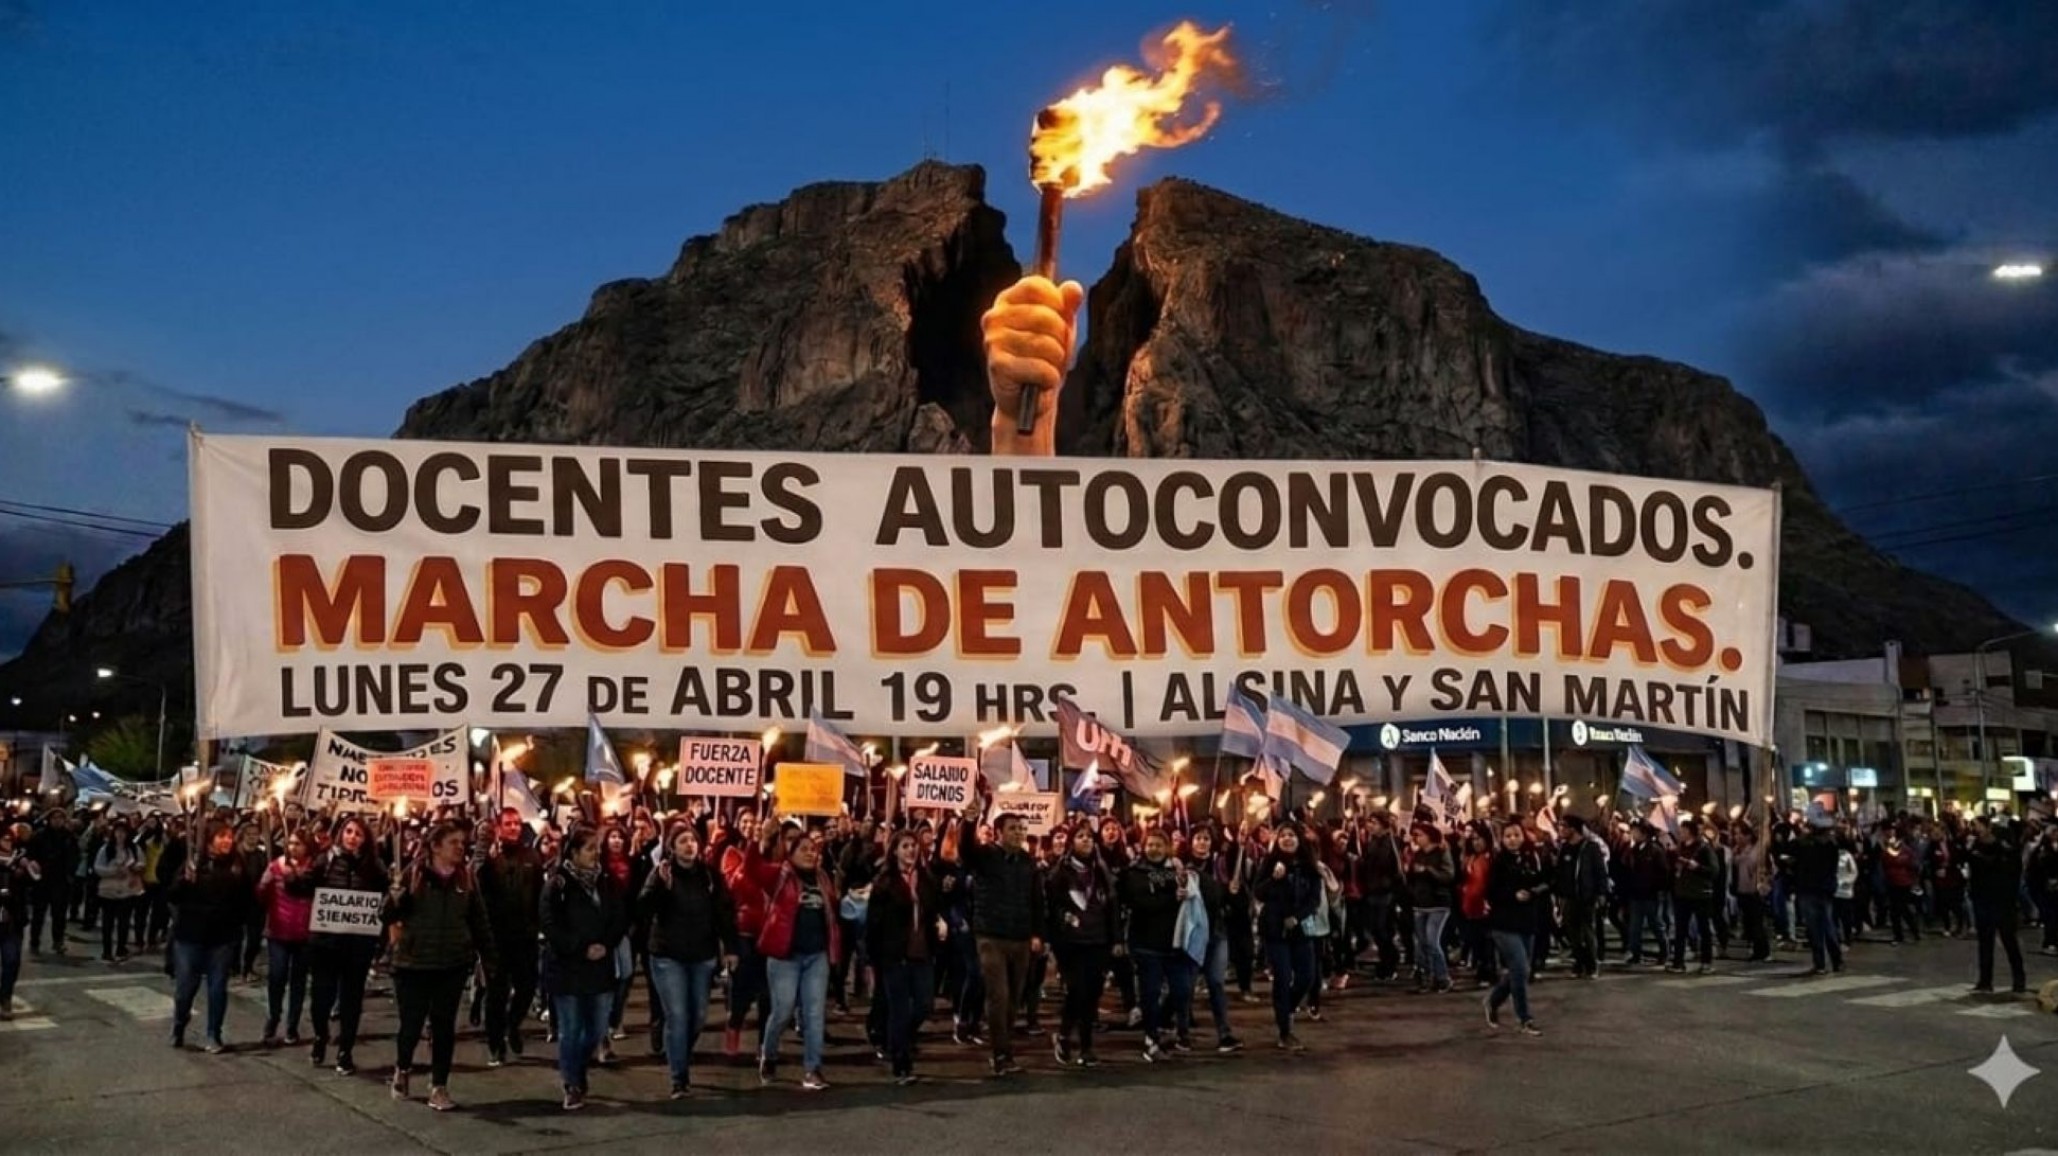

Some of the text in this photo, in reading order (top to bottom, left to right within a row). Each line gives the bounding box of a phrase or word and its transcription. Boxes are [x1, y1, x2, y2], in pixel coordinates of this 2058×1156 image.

[268, 447, 1755, 570] DOCENTES AUTOCONVOCADOS.
[274, 553, 1745, 674] MARCHA DE ANTORCHAS.
[280, 663, 468, 718] LUNES
[490, 664, 563, 713] 27
[588, 676, 648, 714] DE
[670, 666, 854, 720] ABRIL
[880, 671, 952, 722] 19
[1159, 668, 1366, 721] ALSINA
[1384, 674, 1412, 711] Y
[1430, 667, 1540, 715] SAN
[1563, 675, 1749, 733] MARTÍN
[685, 766, 756, 786] DOCENTE
[319, 893, 379, 909] SALARIO
